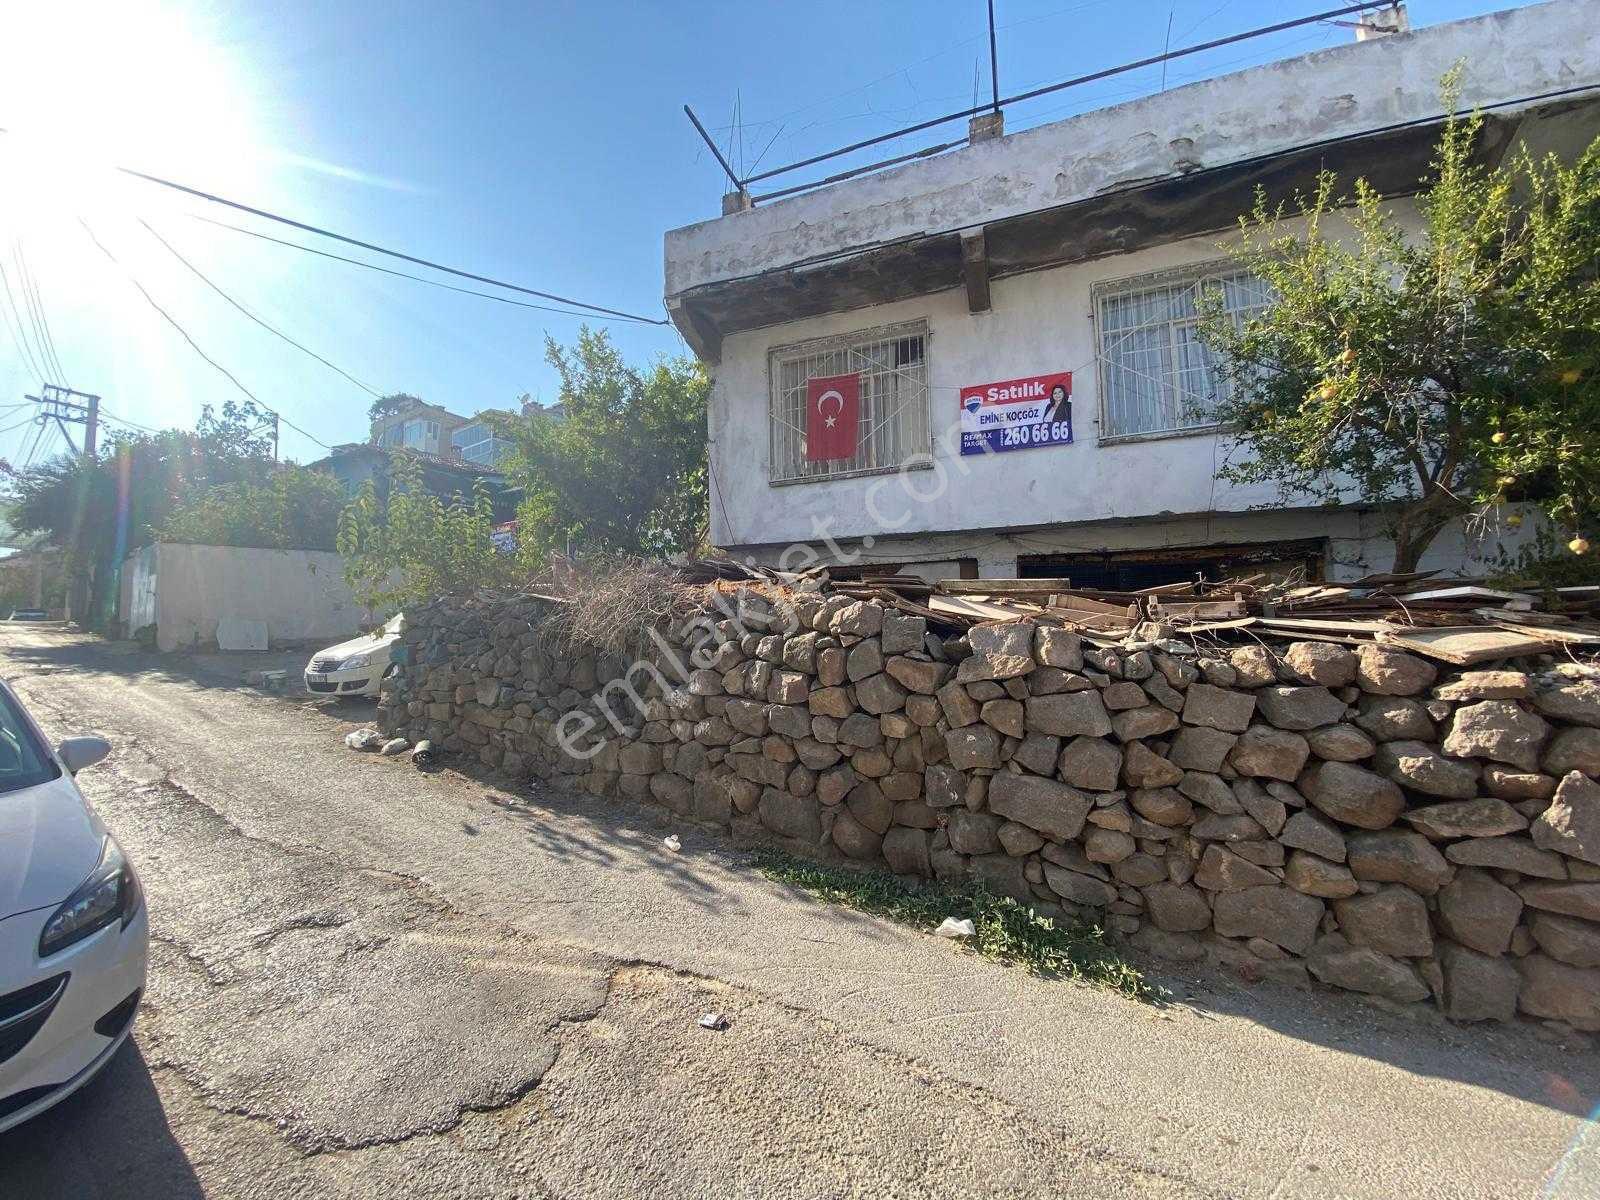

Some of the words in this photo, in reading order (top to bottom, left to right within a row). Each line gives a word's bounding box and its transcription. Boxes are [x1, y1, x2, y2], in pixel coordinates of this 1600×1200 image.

[987, 381, 1046, 402] Satılık
[980, 412, 1005, 425] EMİNE
[1006, 407, 1040, 422] KOÇGÖZ
[1004, 426, 1030, 446] 260
[1032, 423, 1050, 443] 66
[1051, 421, 1069, 441] 66
